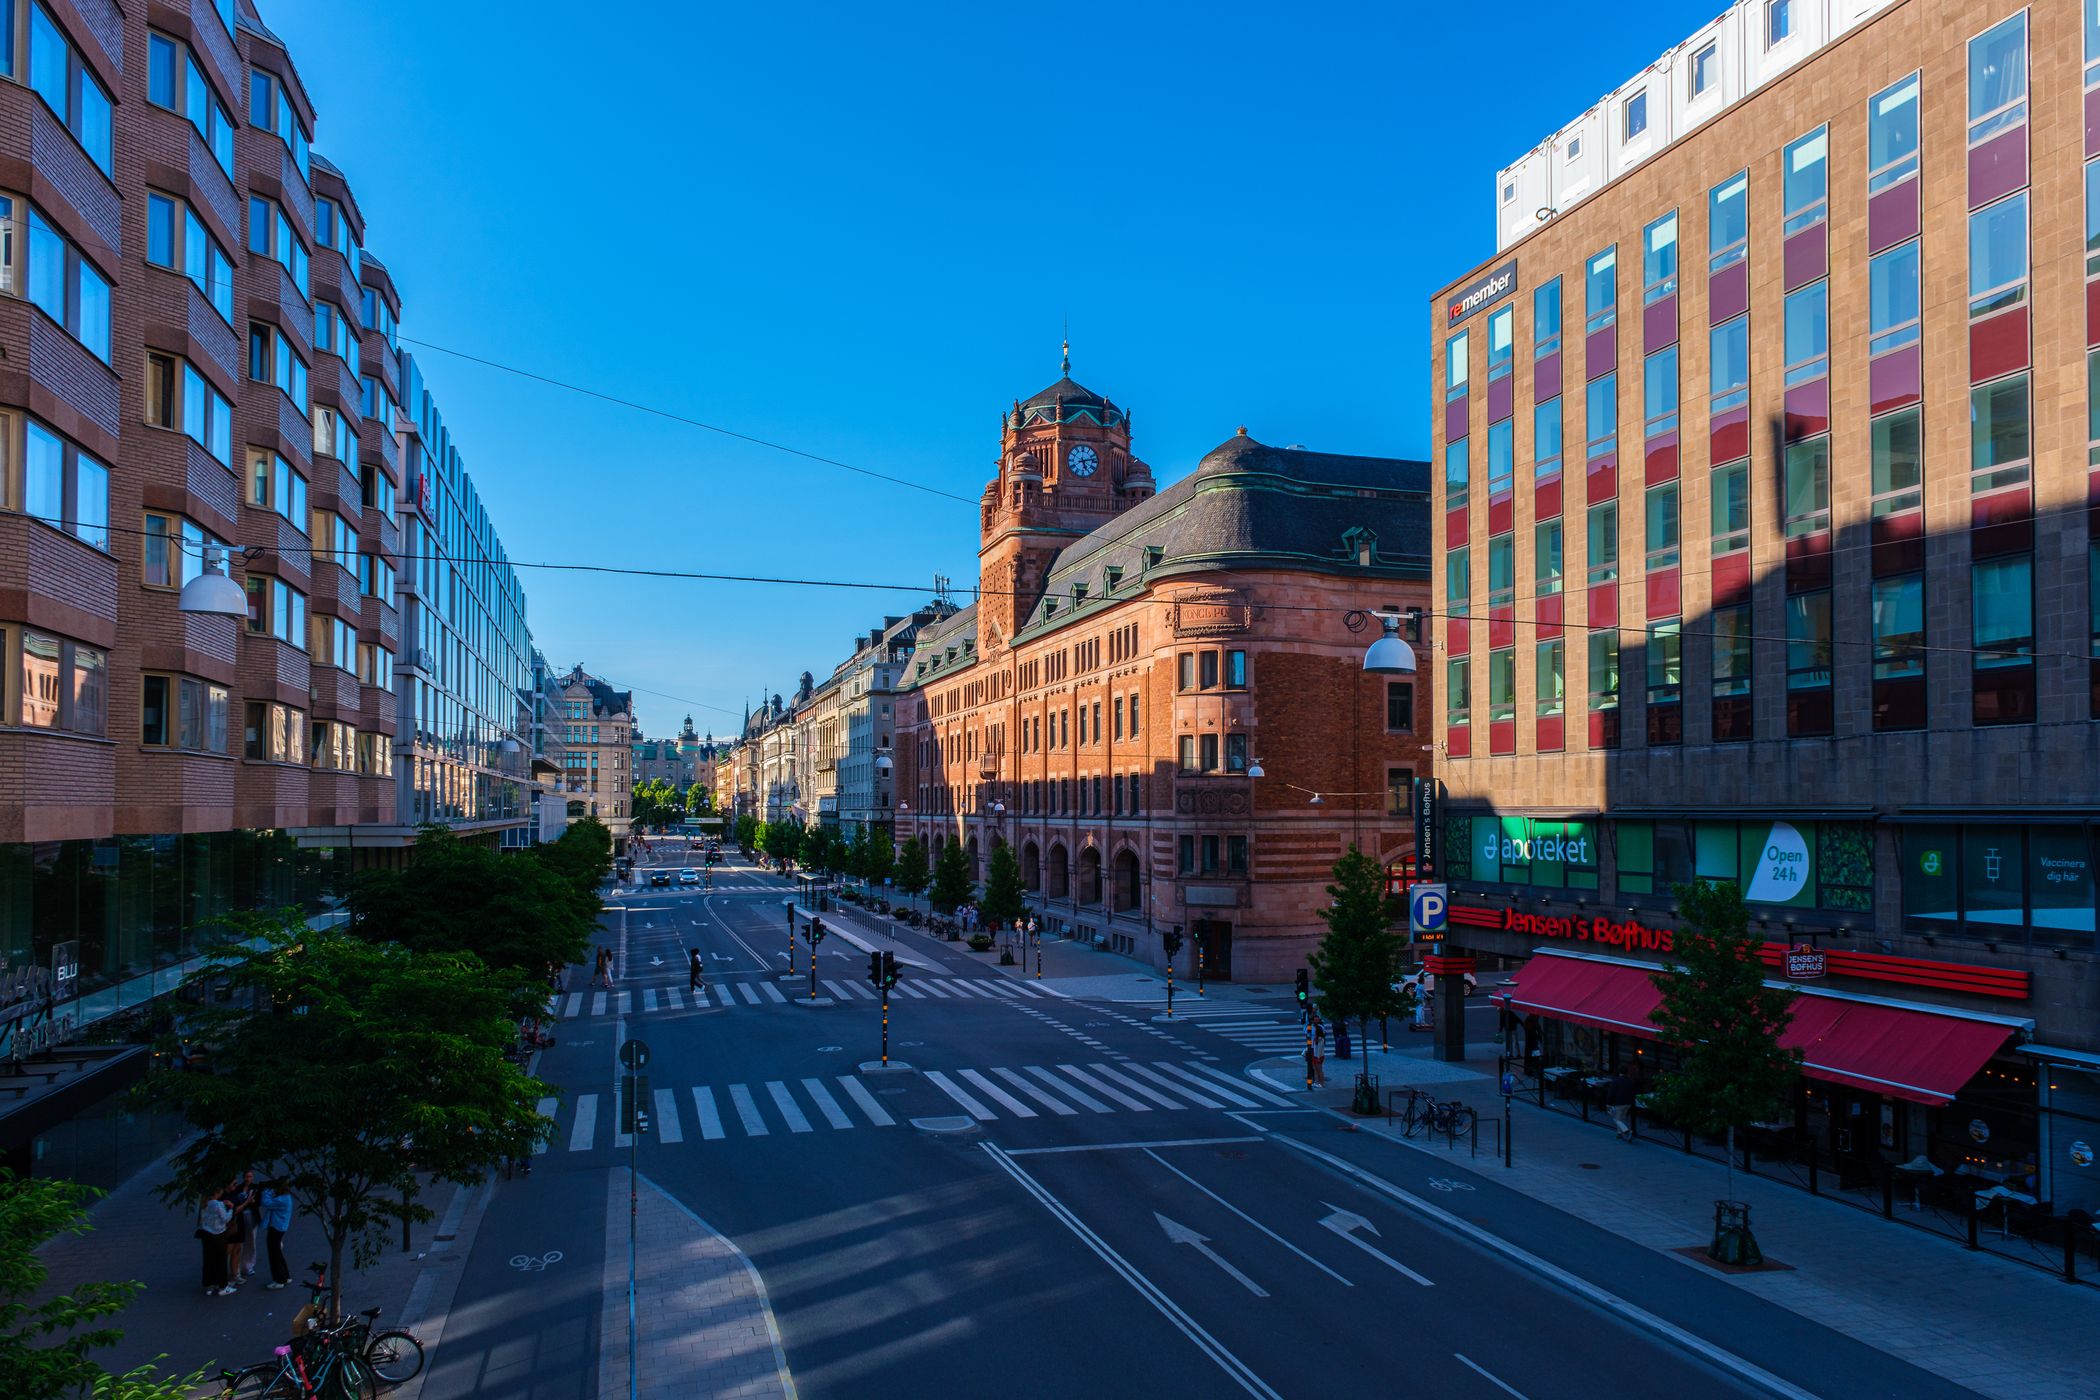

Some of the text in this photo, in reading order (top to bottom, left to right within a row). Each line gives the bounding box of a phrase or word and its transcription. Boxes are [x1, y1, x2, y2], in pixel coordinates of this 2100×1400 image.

[1501, 833, 1588, 865] apoteket
[1767, 845, 1802, 864] Open
[2040, 856, 2086, 869] Vaccinera
[2046, 870, 2080, 883] dig här
[1422, 896, 1443, 925] P
[1503, 906, 1675, 953] Jensen's Bøfhus
[1789, 954, 1824, 964] JENSEN'S
[57, 962, 78, 981] BLU
